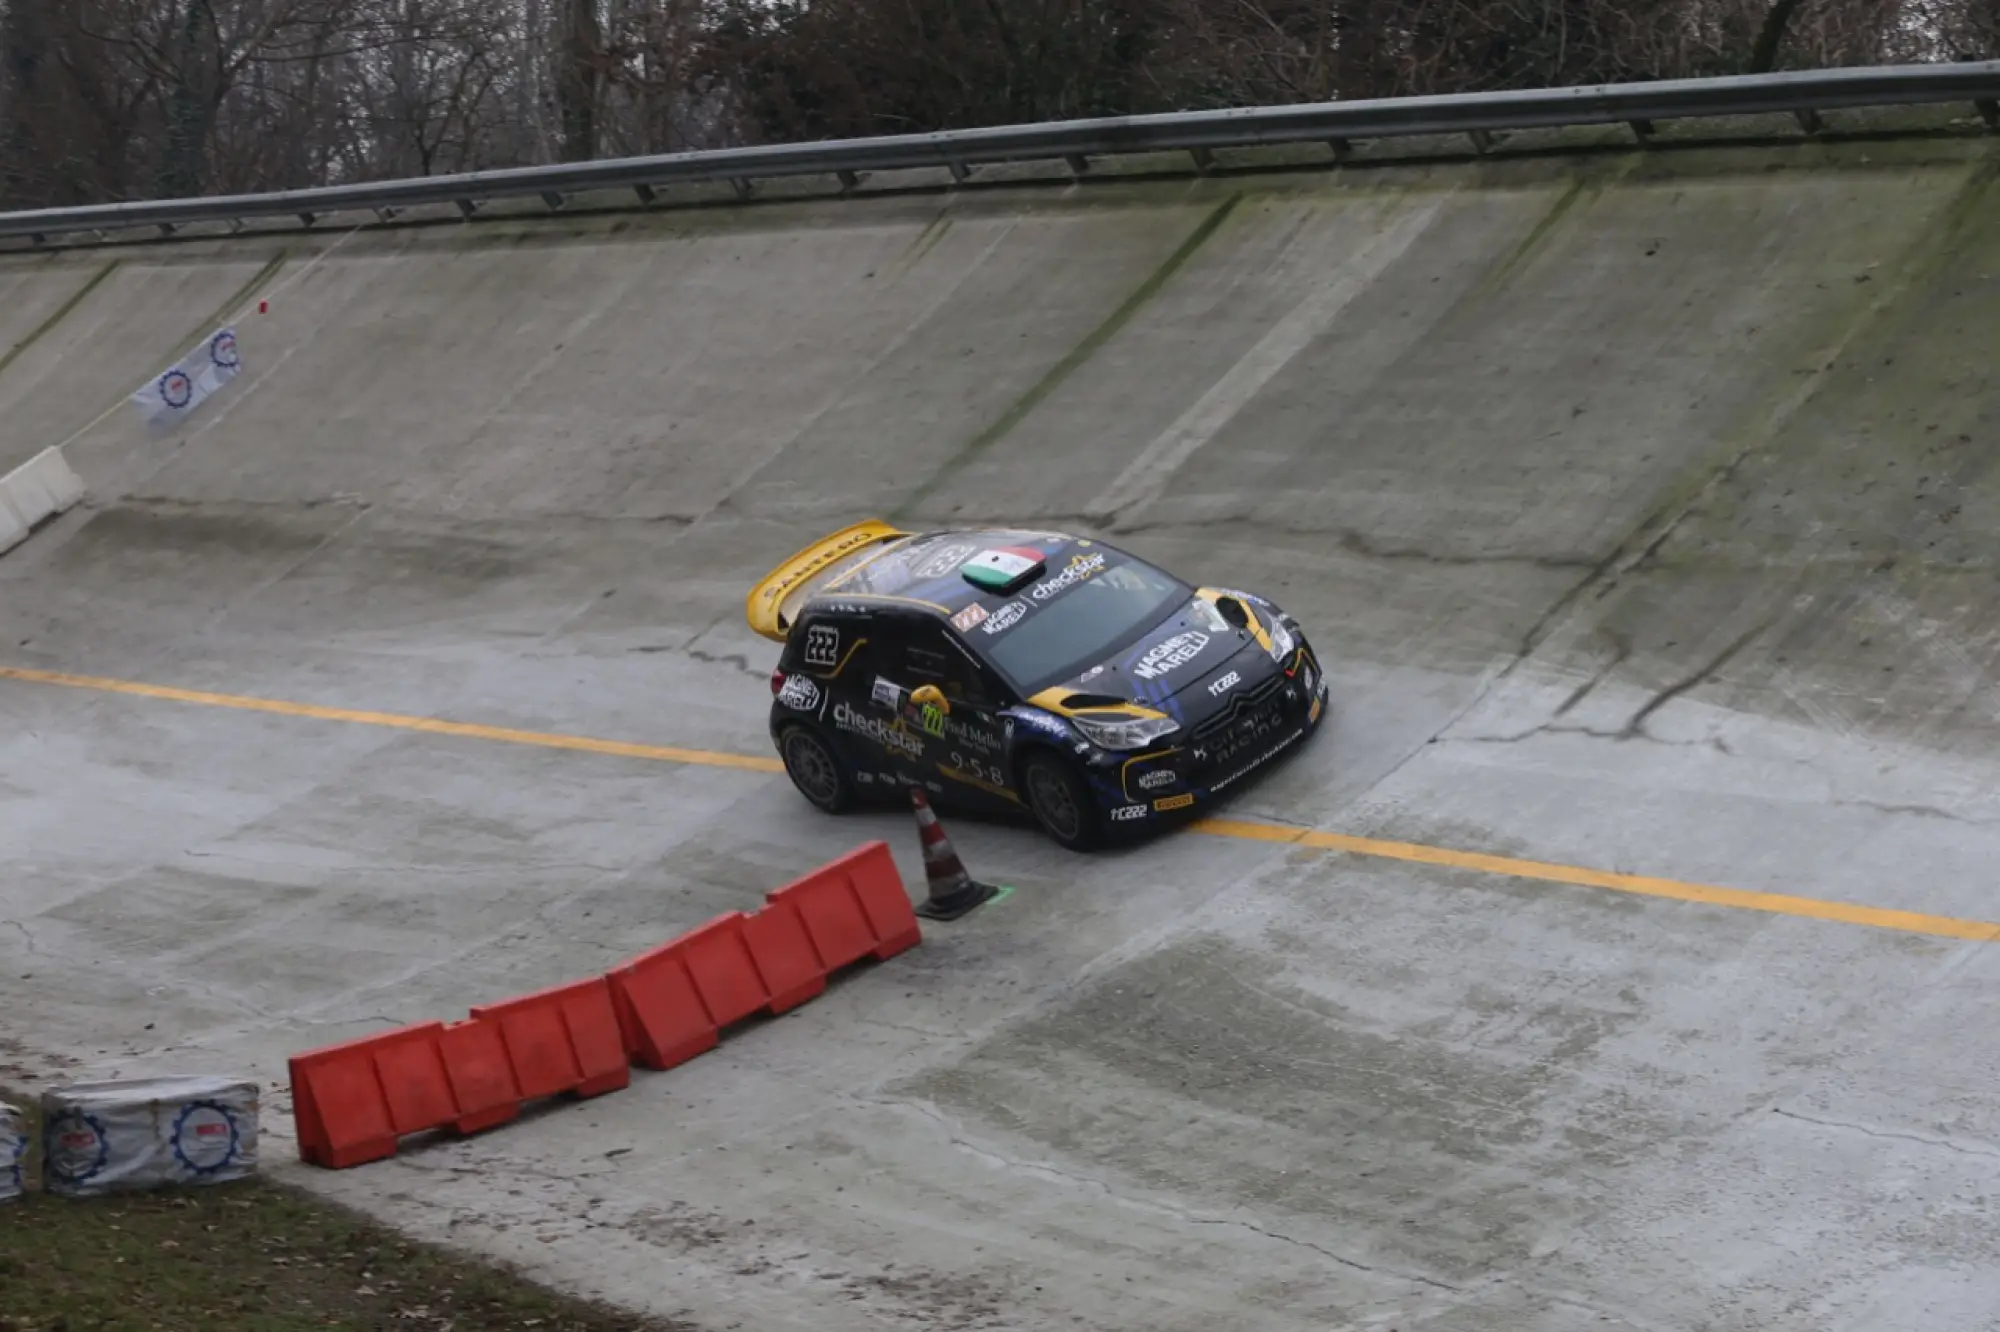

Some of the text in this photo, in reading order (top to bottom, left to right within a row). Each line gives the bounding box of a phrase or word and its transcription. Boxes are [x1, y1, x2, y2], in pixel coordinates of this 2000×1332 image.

[1032, 553, 1105, 600] checkstar
[807, 630, 838, 663] 222
[1134, 630, 1198, 676] MAGNETI
[1137, 633, 1210, 680] MARELLI
[833, 701, 925, 757] checkstar
